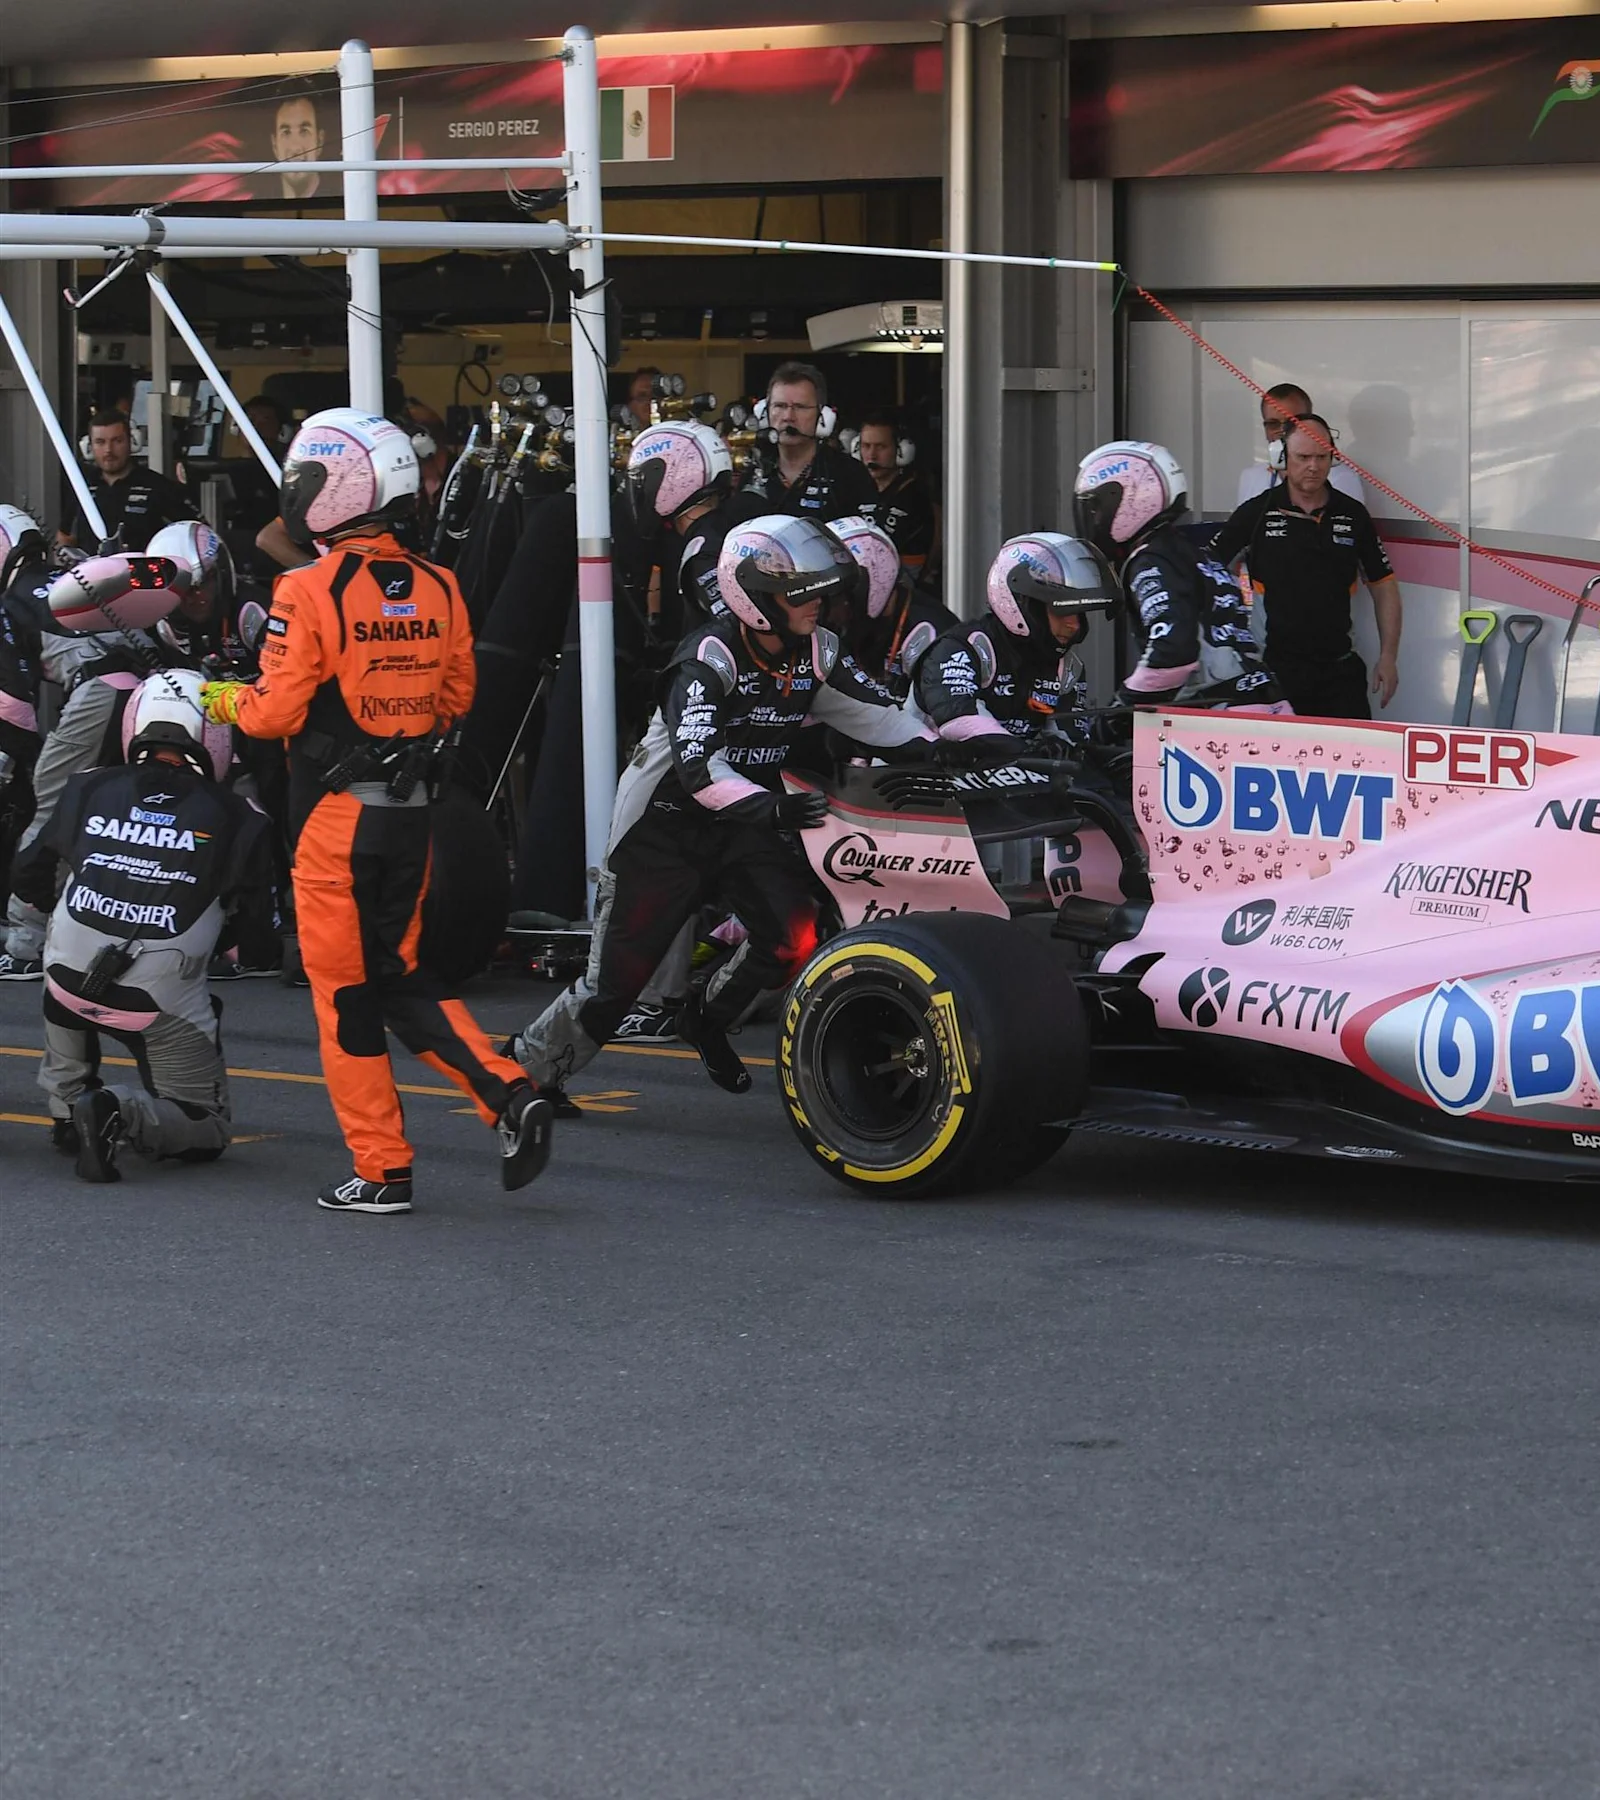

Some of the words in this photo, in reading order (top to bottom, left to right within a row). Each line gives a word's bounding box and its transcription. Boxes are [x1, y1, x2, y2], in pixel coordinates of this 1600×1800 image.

[448, 121, 495, 138] SERGIO
[497, 119, 540, 136] PEREZ
[308, 443, 347, 457] BWT
[643, 440, 673, 457] BWT
[1099, 461, 1130, 481] BWT
[1265, 529, 1288, 537] NEC
[354, 618, 441, 643] SAHARA
[681, 711, 712, 725] HYPE
[676, 725, 718, 738] QUAKER
[1406, 731, 1530, 787] PER
[1232, 765, 1395, 842] BWT
[142, 810, 176, 826] BWT
[85, 815, 196, 851] SAHARA
[113, 853, 158, 870] SAHARA
[840, 847, 914, 872] QUAKER
[918, 857, 975, 876] STATE
[1383, 862, 1532, 914] KINGFISHER
[69, 885, 178, 934] KINGFISHER
[1280, 905, 1356, 931] 利来国际
[1417, 900, 1481, 918] PREMIUM
[1269, 933, 1345, 951] W66.COM
[1237, 980, 1351, 1035] FXTM
[781, 996, 812, 1129] ZERO
